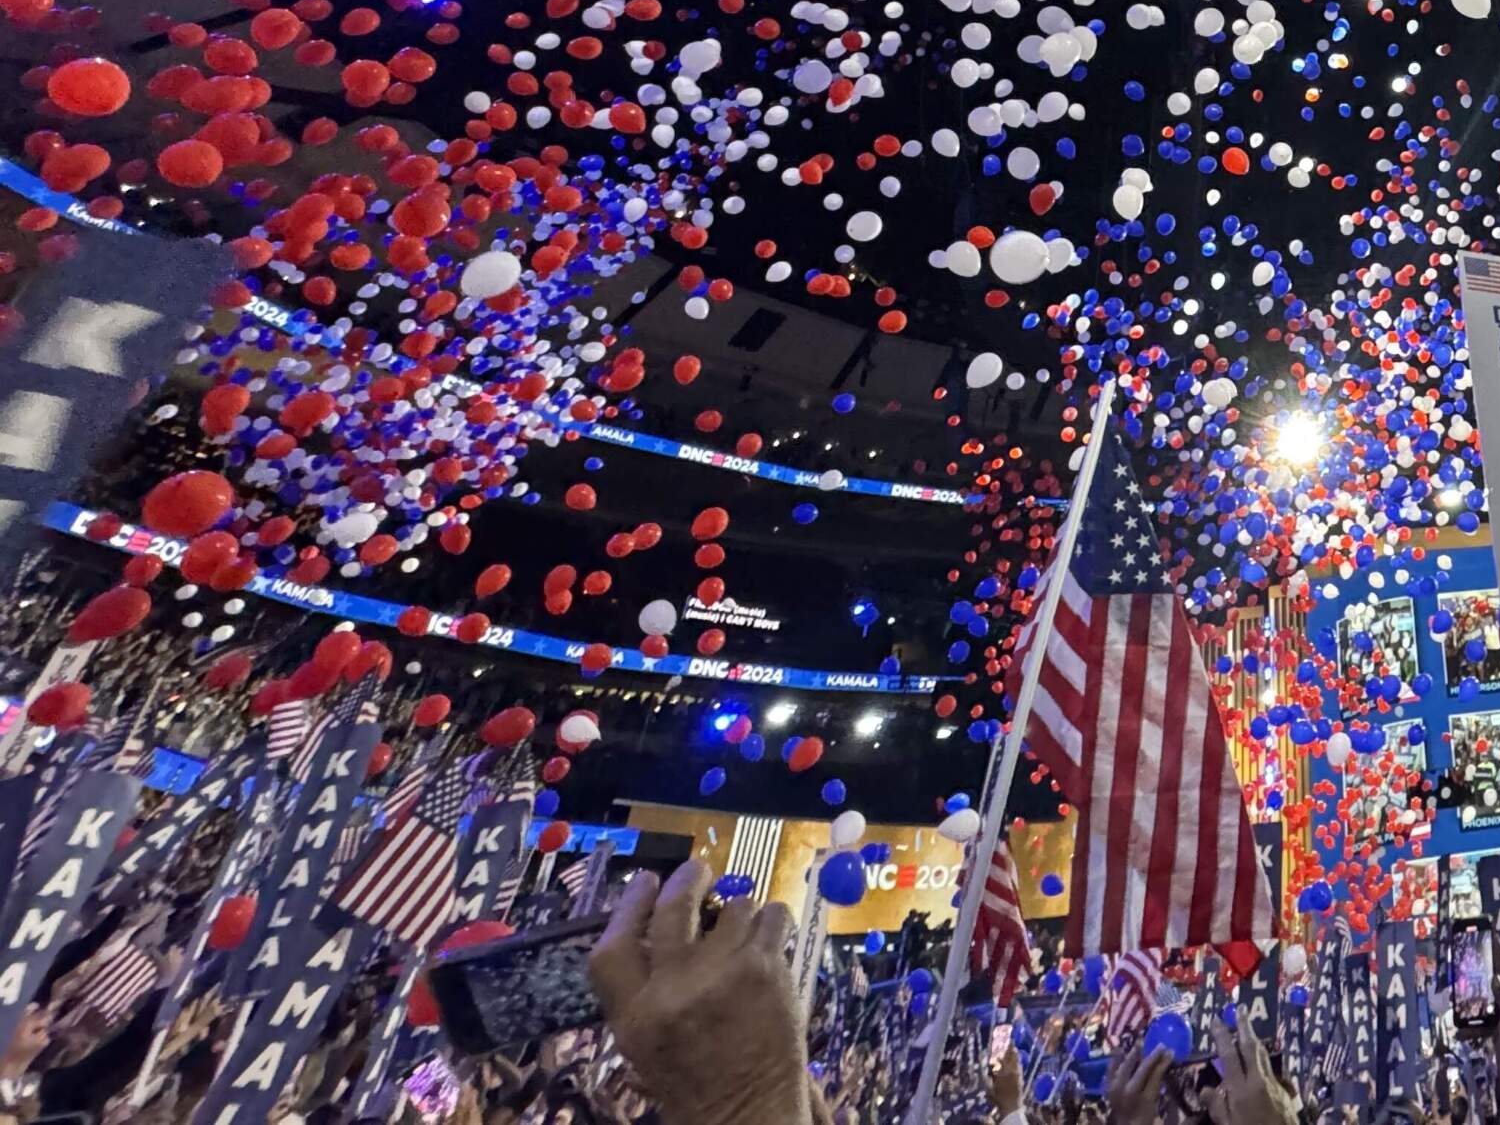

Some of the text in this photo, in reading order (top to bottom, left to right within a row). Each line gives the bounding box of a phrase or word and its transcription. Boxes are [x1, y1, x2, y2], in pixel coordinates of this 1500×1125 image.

[244, 295, 289, 327] 2024
[679, 445, 713, 465] DNC
[723, 455, 759, 474] 2024
[891, 484, 923, 499] DNC
[932, 489, 963, 504] 2024
[689, 658, 729, 677] DNC
[743, 665, 784, 683] 2024
[826, 675, 879, 689] KAMALA
[248, 749, 357, 972] KAMALA
[863, 863, 898, 891] NC
